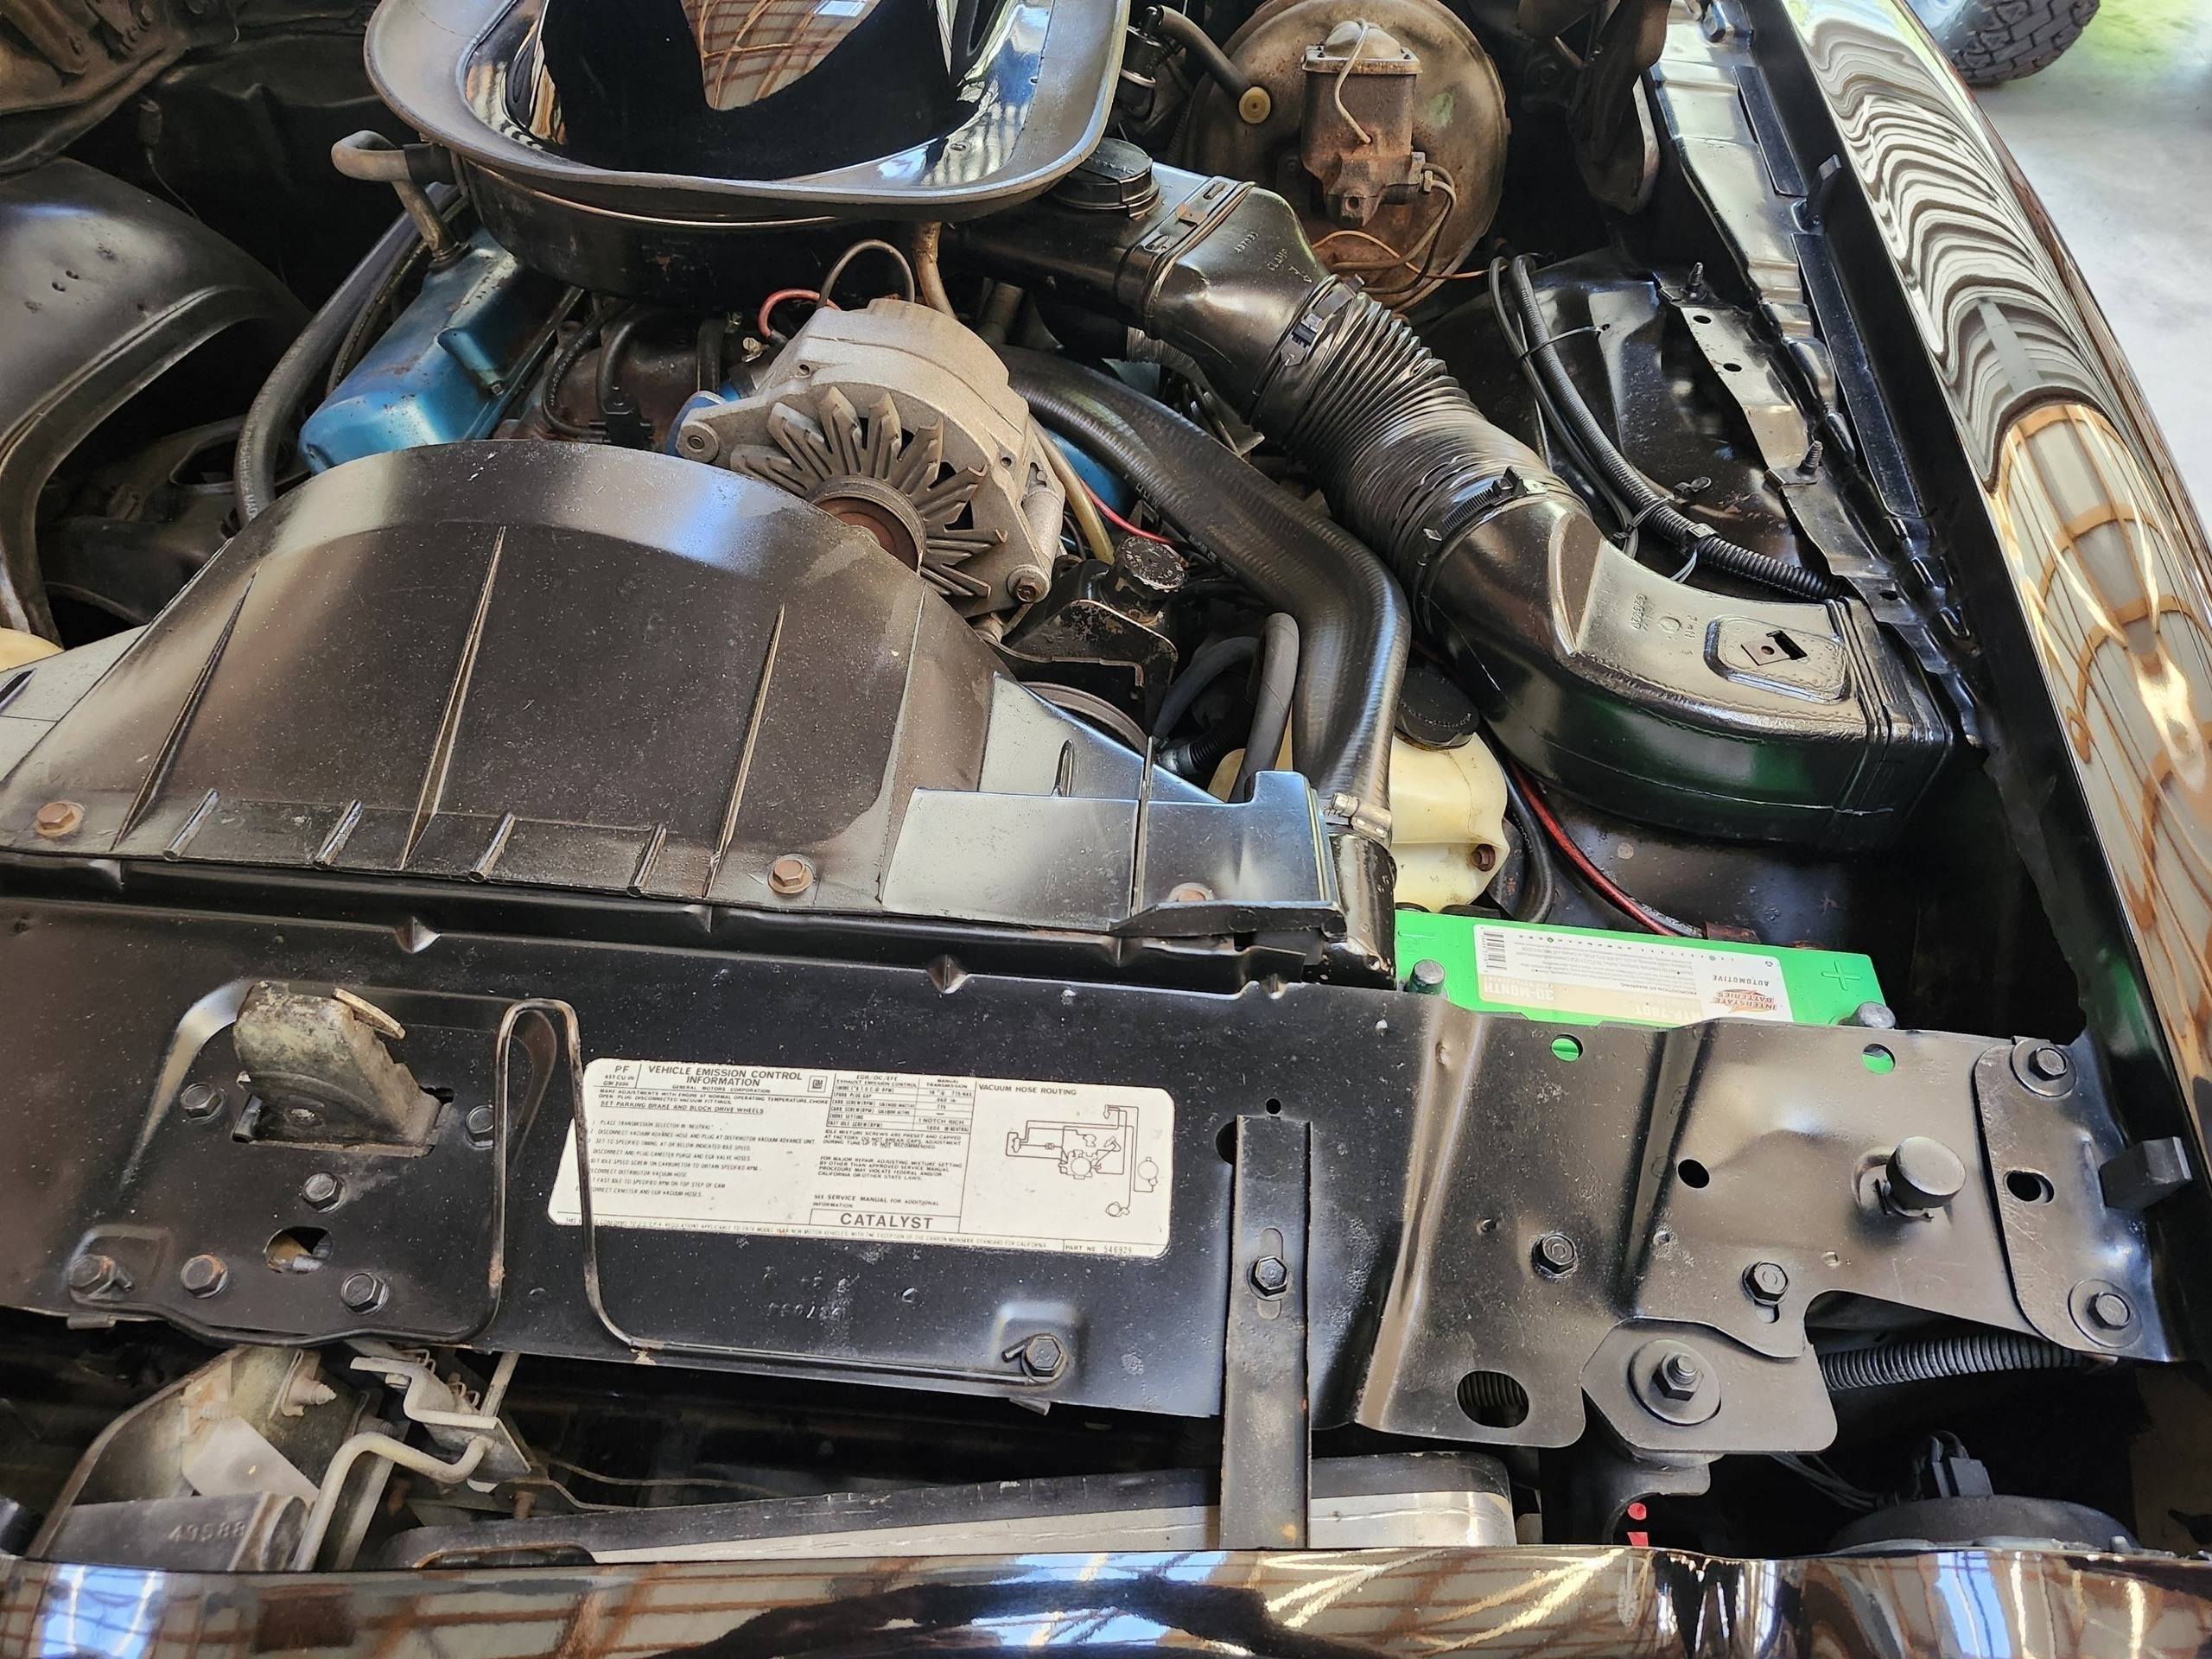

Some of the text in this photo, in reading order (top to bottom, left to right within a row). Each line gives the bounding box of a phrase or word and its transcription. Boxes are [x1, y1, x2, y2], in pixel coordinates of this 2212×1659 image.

[1712, 975, 1769, 986] AUTOMOTIVE
[1483, 981, 1555, 1001] 30-MONTH
[1717, 991, 1773, 1002] BATTERIES
[1713, 997, 1777, 1009] INTERSTATE
[648, 1065, 803, 1080] VEHICLE EMISSION CONTROL
[686, 1075, 760, 1086] INFORMATION
[840, 1212, 933, 1229] CATALYST
